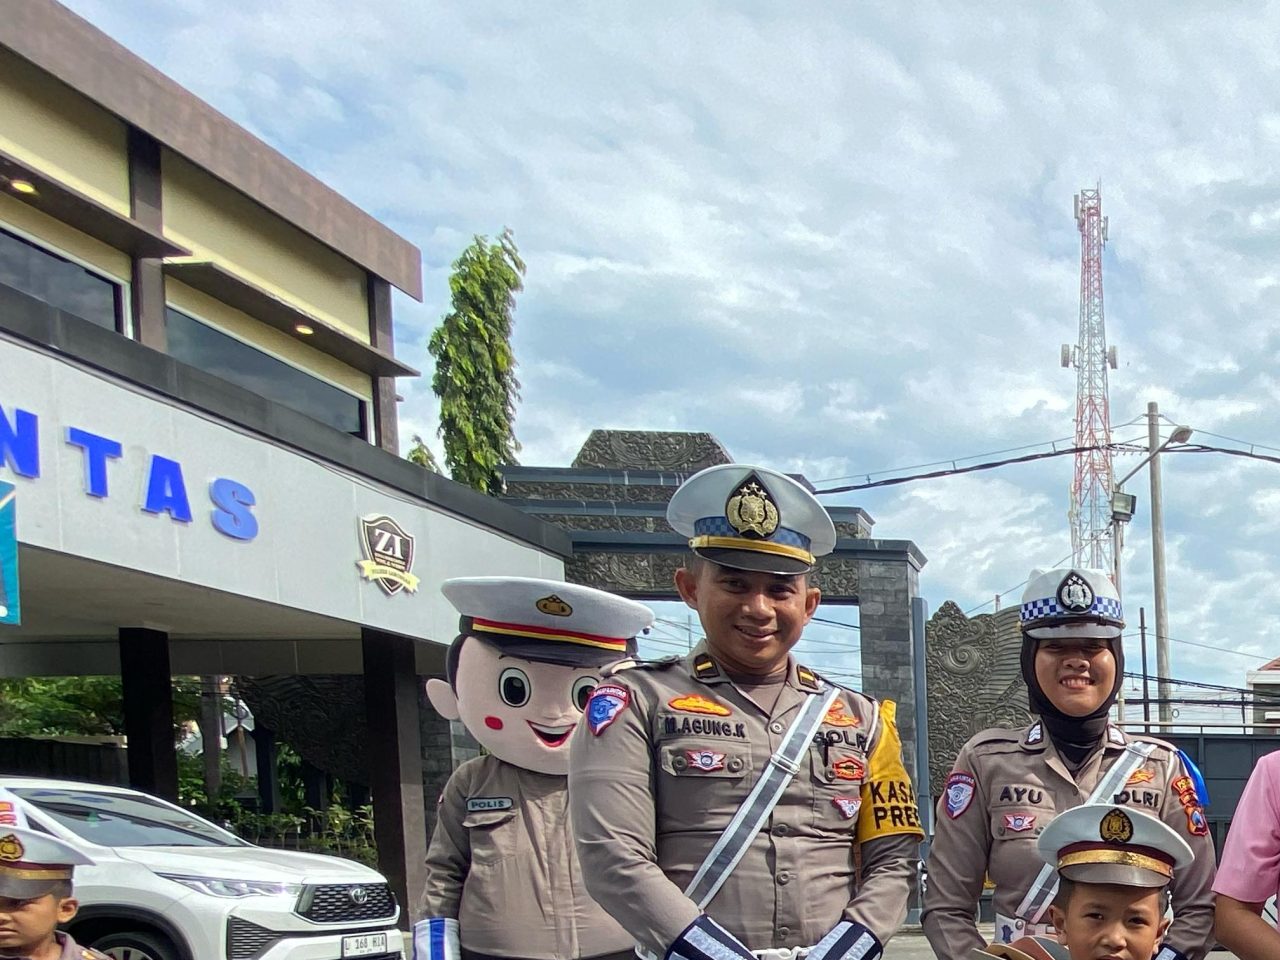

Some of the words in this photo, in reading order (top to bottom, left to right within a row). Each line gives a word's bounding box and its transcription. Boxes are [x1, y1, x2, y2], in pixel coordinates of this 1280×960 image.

[375, 528, 404, 559] ZI
[812, 729, 869, 750] POLR
[999, 786, 1042, 805] AYU
